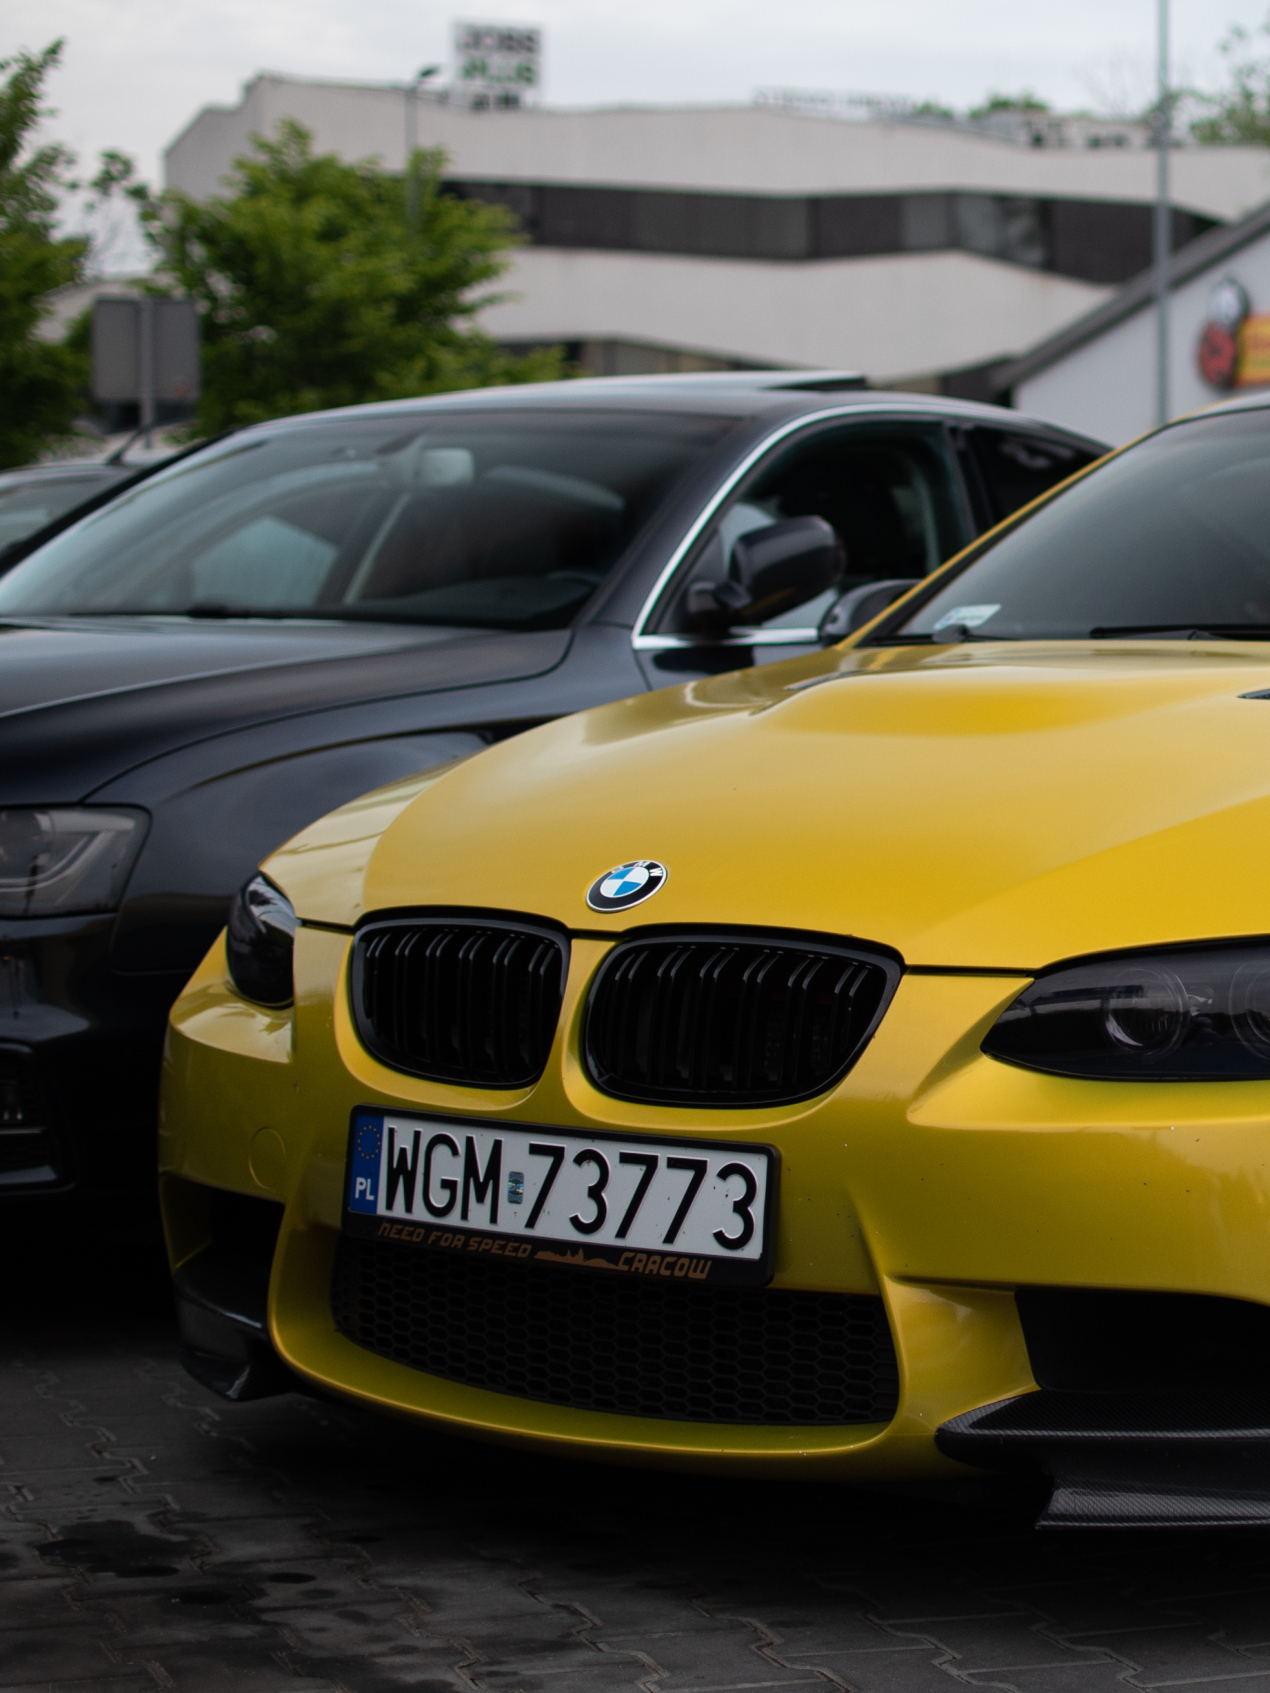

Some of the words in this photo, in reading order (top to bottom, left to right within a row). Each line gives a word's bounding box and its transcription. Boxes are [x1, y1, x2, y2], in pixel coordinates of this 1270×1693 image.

[355, 1176, 375, 1201] PL
[386, 1125, 504, 1226] WGM
[524, 1142, 758, 1251] 73773
[378, 1222, 425, 1242] NEED
[427, 1231, 465, 1249] FOR
[466, 1236, 532, 1258] SPEED
[618, 1251, 712, 1280] CRACOW
